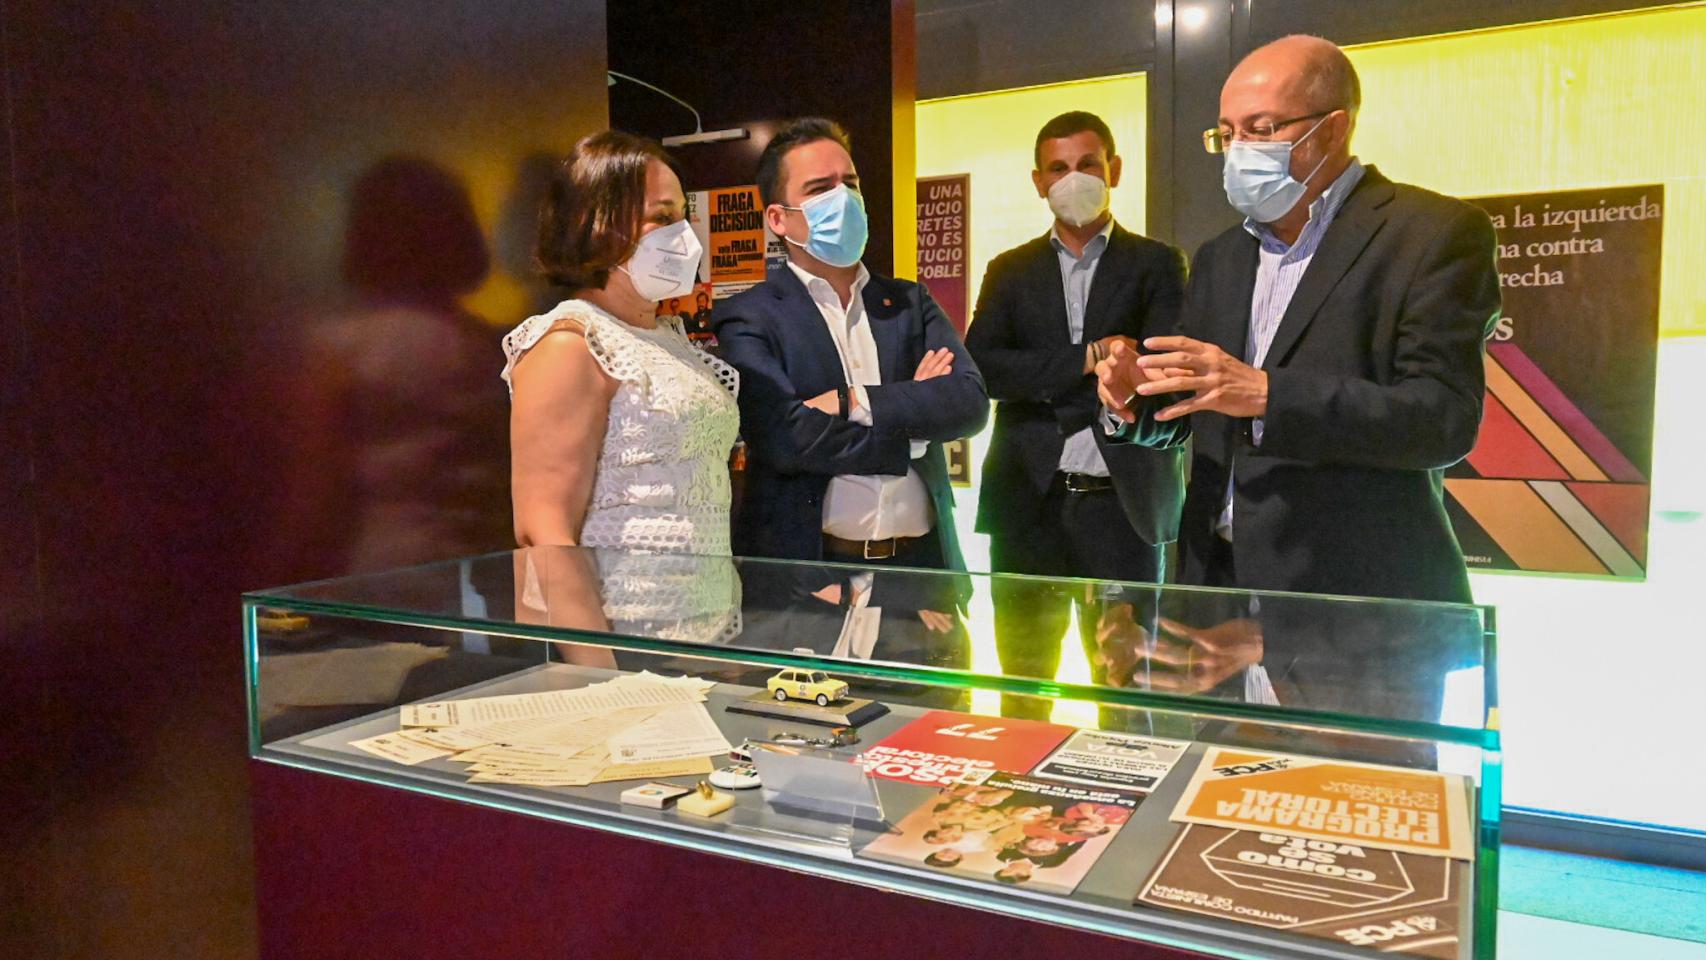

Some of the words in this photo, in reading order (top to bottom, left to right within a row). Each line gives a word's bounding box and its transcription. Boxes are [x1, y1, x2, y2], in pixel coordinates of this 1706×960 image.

[929, 183, 962, 200] UNA
[718, 192, 753, 213] FRAGA
[916, 200, 962, 217] TUCIO
[1513, 205, 1536, 228] la
[1542, 195, 1661, 232] izquierda
[916, 216, 962, 232] RETES
[731, 239, 757, 253] FRAGA
[917, 233, 937, 247] NO
[942, 231, 962, 246] ES
[1526, 235, 1604, 257] contra
[712, 254, 738, 268] FRAGA
[917, 248, 962, 263] TUCIO
[1498, 264, 1565, 287] recha
[935, 723, 1006, 741] 77
[1212, 761, 1277, 777] PCE
[1241, 788, 1440, 828] ELECTORAL
[1216, 801, 1441, 845] PROGRAMA
[1257, 832, 1367, 858] vota
[1277, 845, 1337, 865] se
[1237, 850, 1377, 882] como
[1234, 905, 1300, 924] PARTIDO
[1334, 919, 1419, 946] PCE
